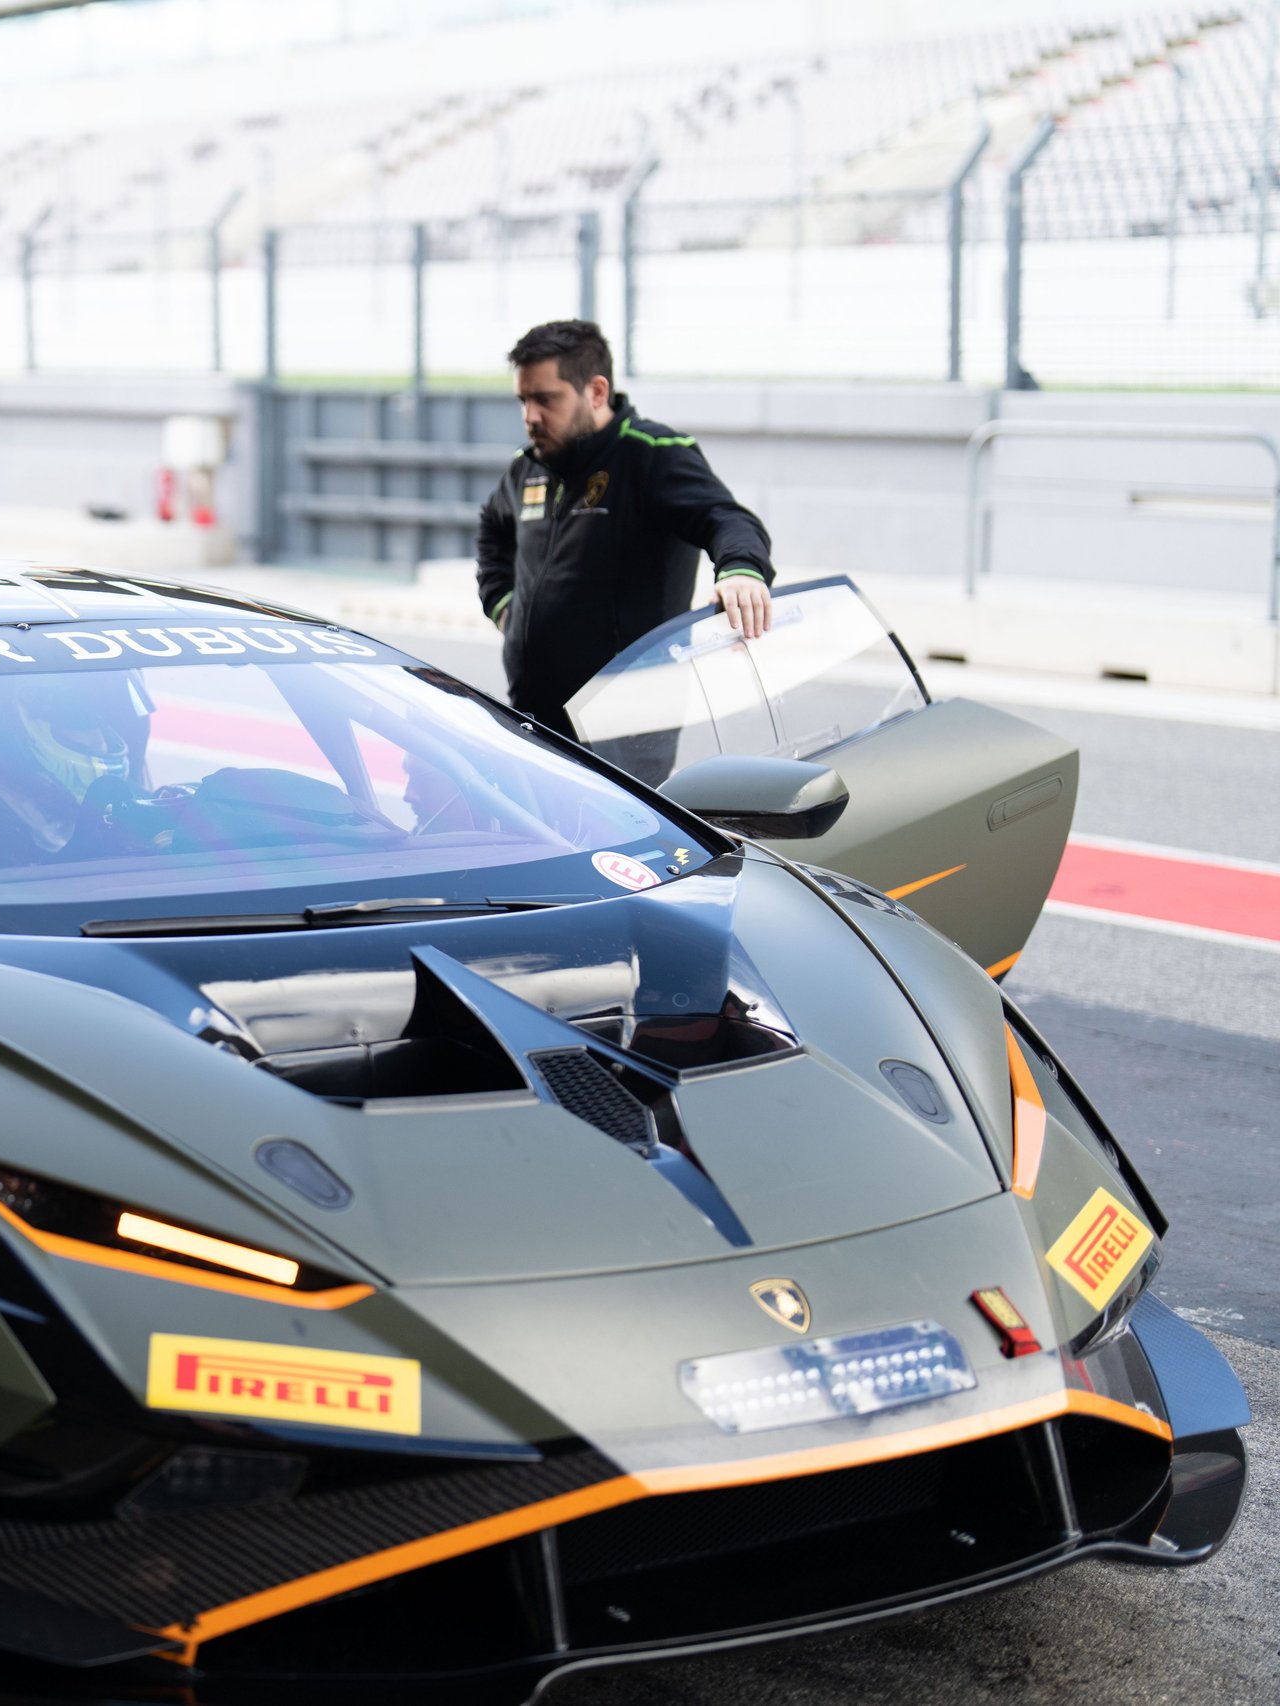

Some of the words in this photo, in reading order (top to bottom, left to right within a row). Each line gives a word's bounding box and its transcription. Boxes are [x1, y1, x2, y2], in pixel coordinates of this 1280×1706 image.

[43, 626, 377, 661] DUBUIS
[611, 861, 646, 883] E
[1065, 1205, 1138, 1290] PIRELLI
[176, 1353, 394, 1414] PIRELLI
